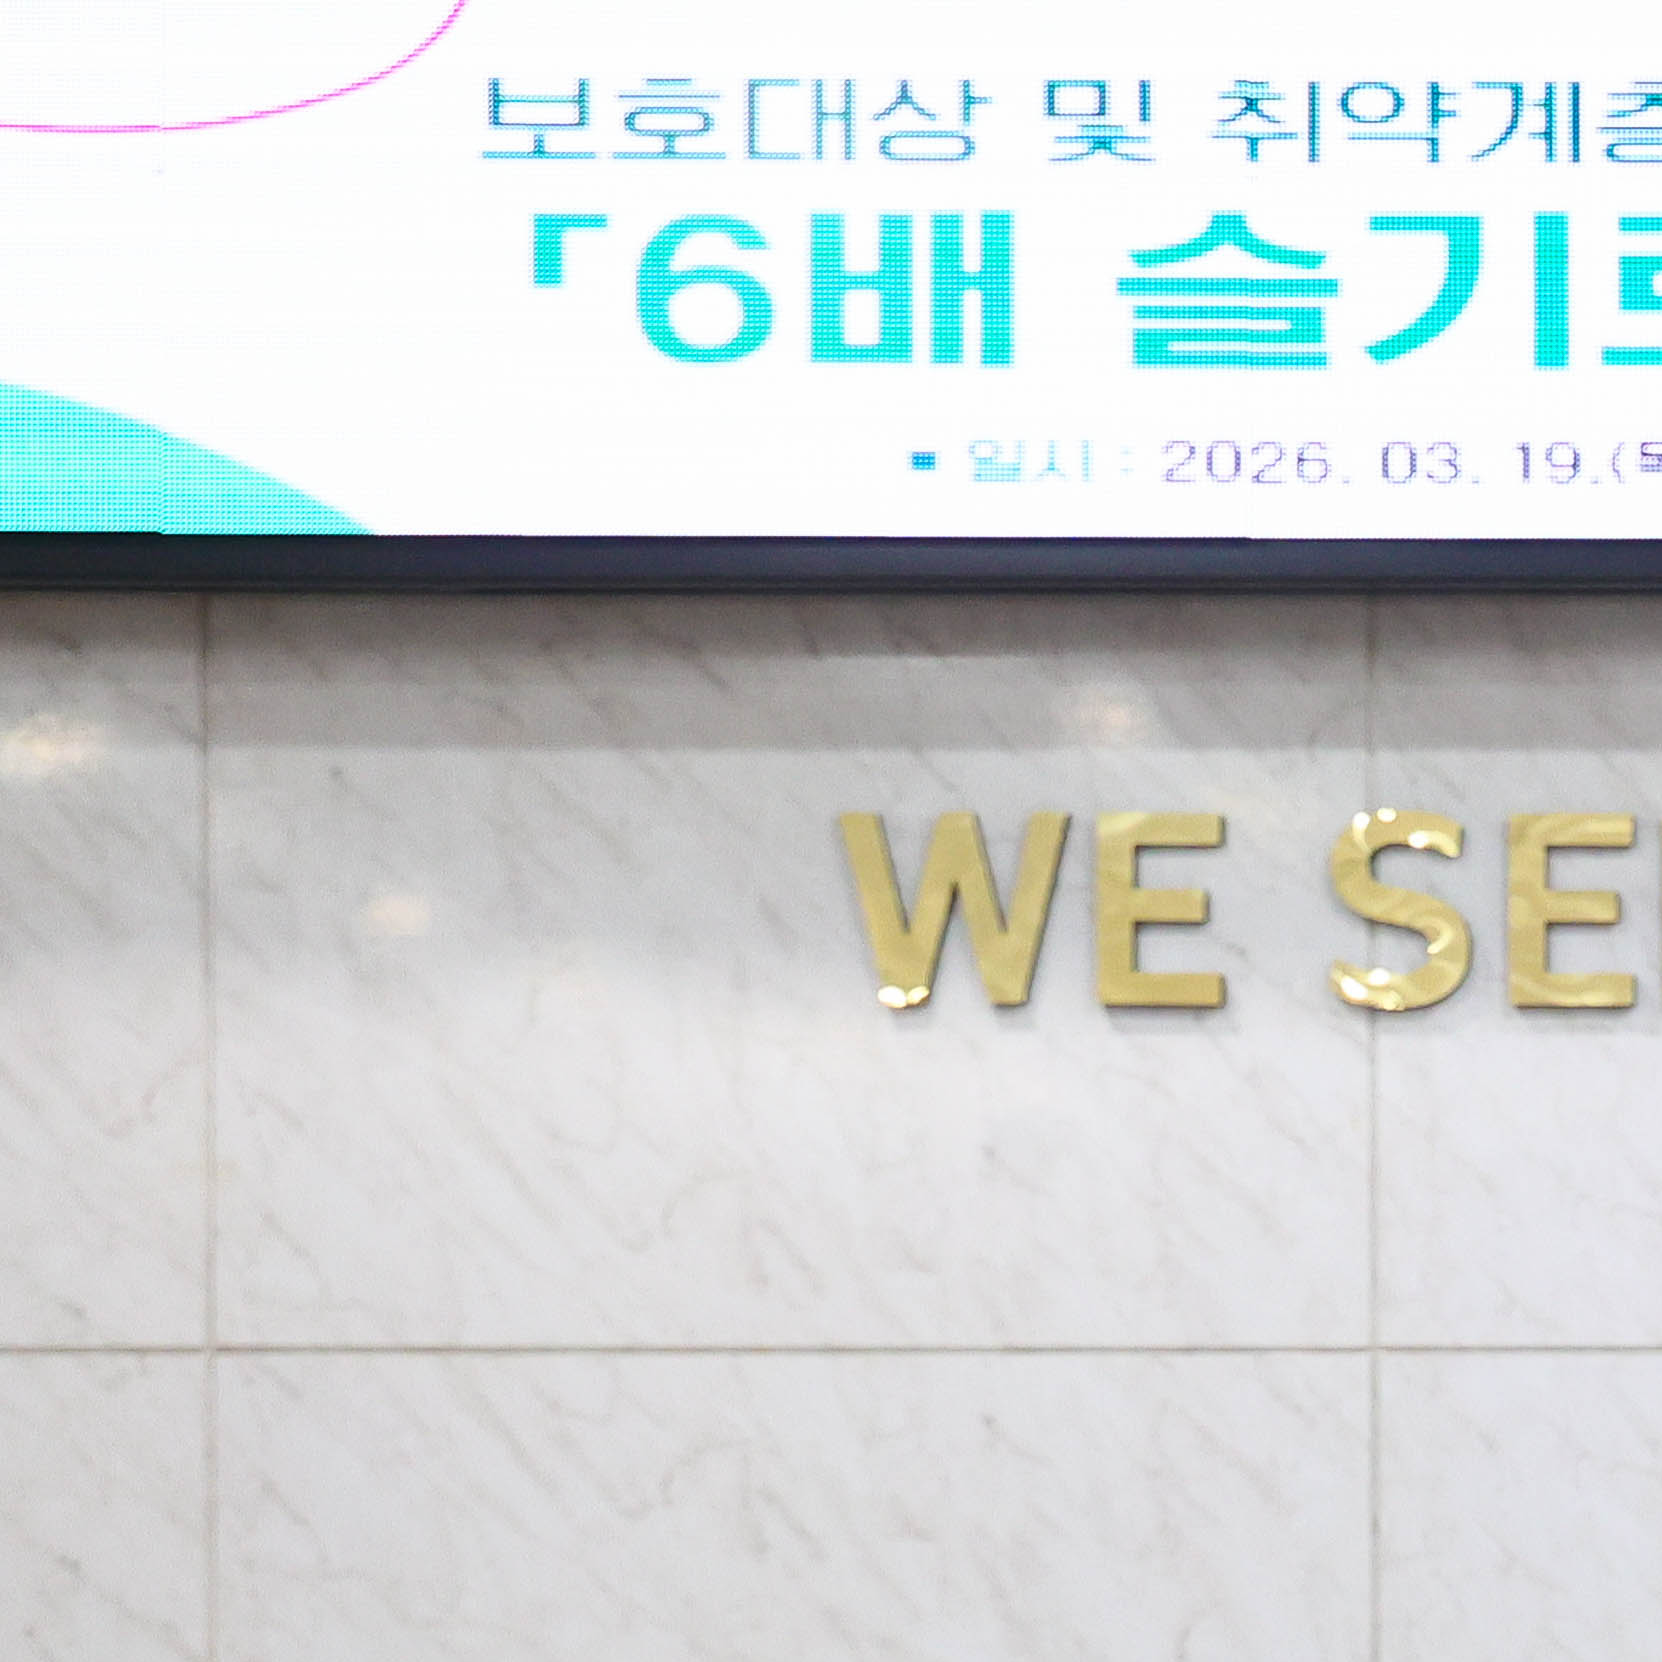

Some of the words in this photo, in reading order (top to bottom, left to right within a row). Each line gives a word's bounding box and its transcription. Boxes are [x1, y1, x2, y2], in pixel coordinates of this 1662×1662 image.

[479, 77, 994, 164] 보호대상
[1042, 78, 1156, 165] 및
[528, 208, 1016, 370] 「6배
[968, 440, 1093, 483] 일시
[1162, 440, 1350, 484] 2026.
[1381, 441, 1480, 484] 03.
[838, 810, 1226, 1010] WE
